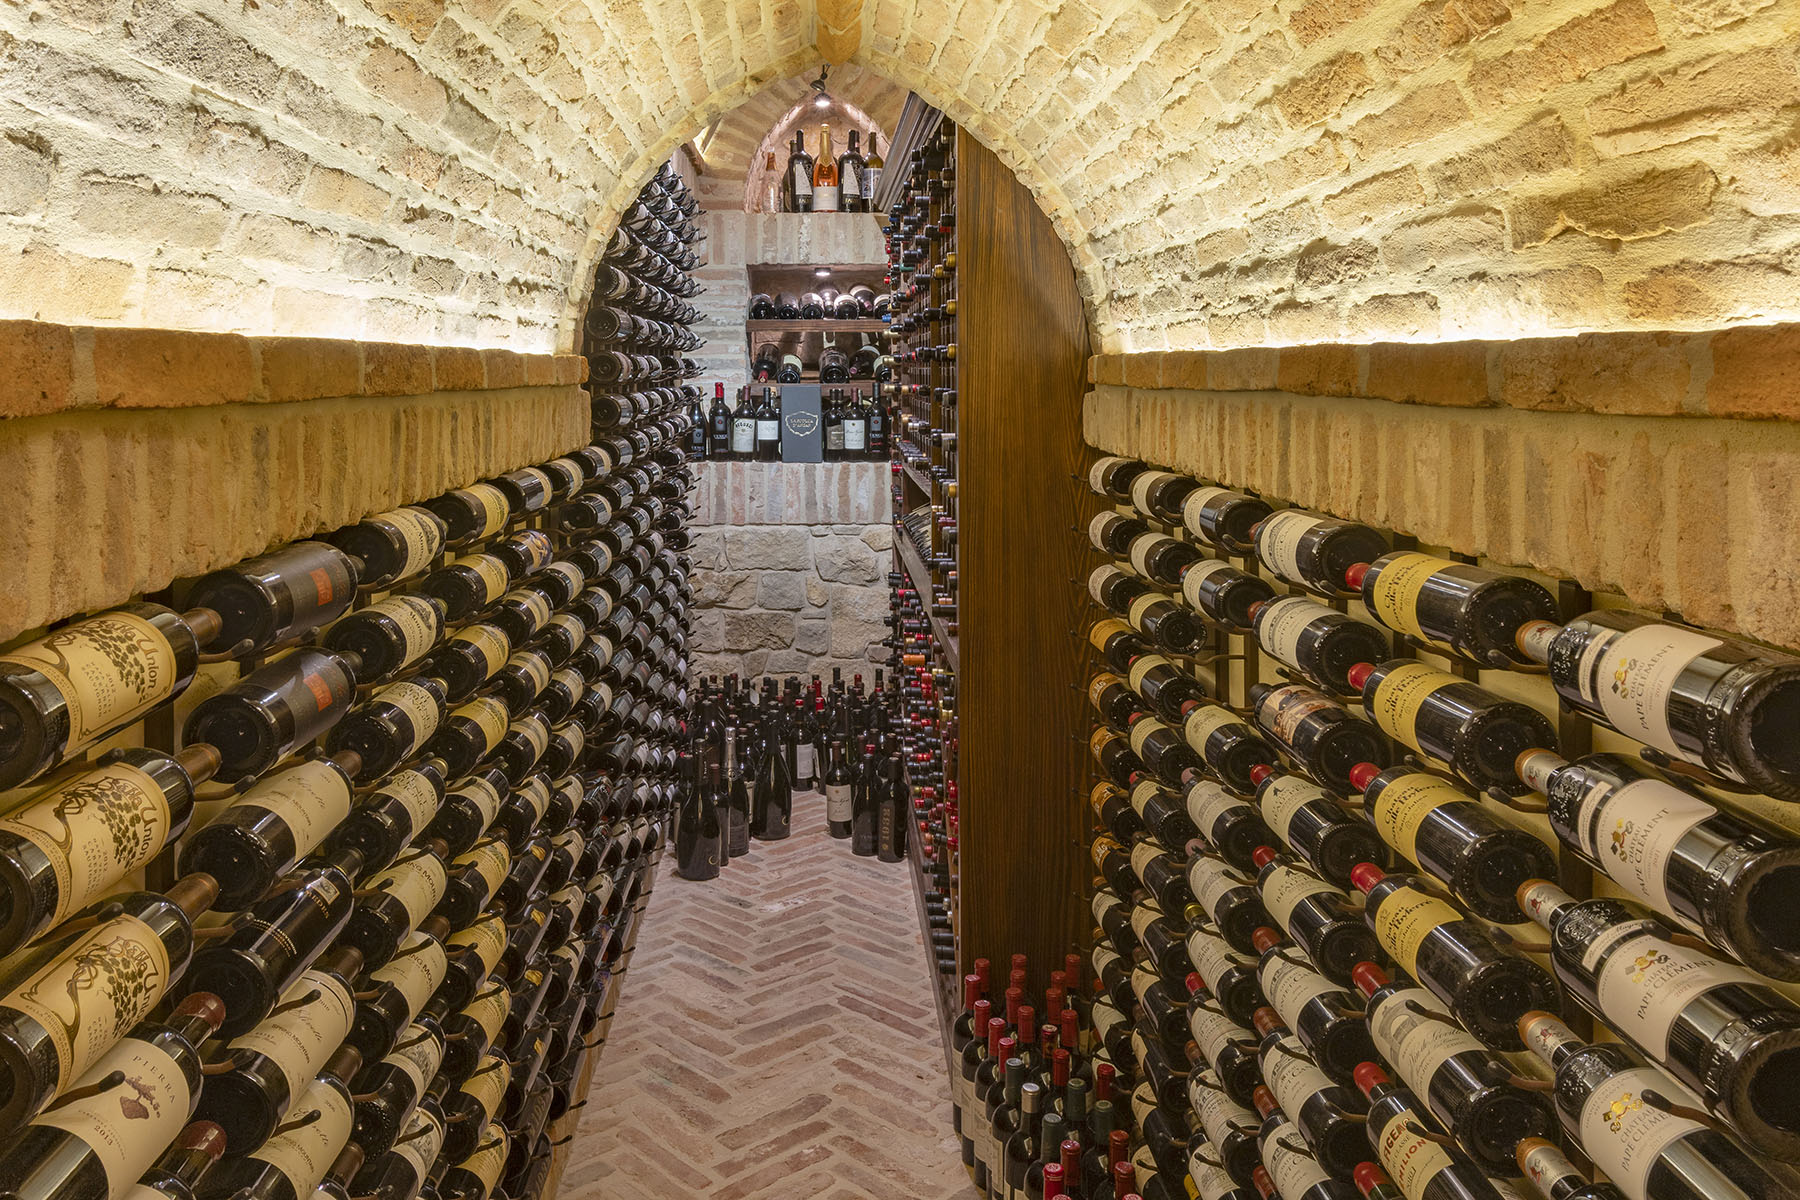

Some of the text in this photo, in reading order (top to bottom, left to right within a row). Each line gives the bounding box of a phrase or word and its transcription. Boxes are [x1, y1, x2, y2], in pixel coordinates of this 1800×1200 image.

[1636, 701, 1650, 731] PAPE
[1635, 866, 1651, 897] PAPE
[1637, 958, 1717, 1020] PAPE CLEMENT
[94, 1125, 114, 1146] 2013
[1619, 1108, 1656, 1145] CHATEAU
[1621, 1111, 1668, 1173] PAPE CLEME
